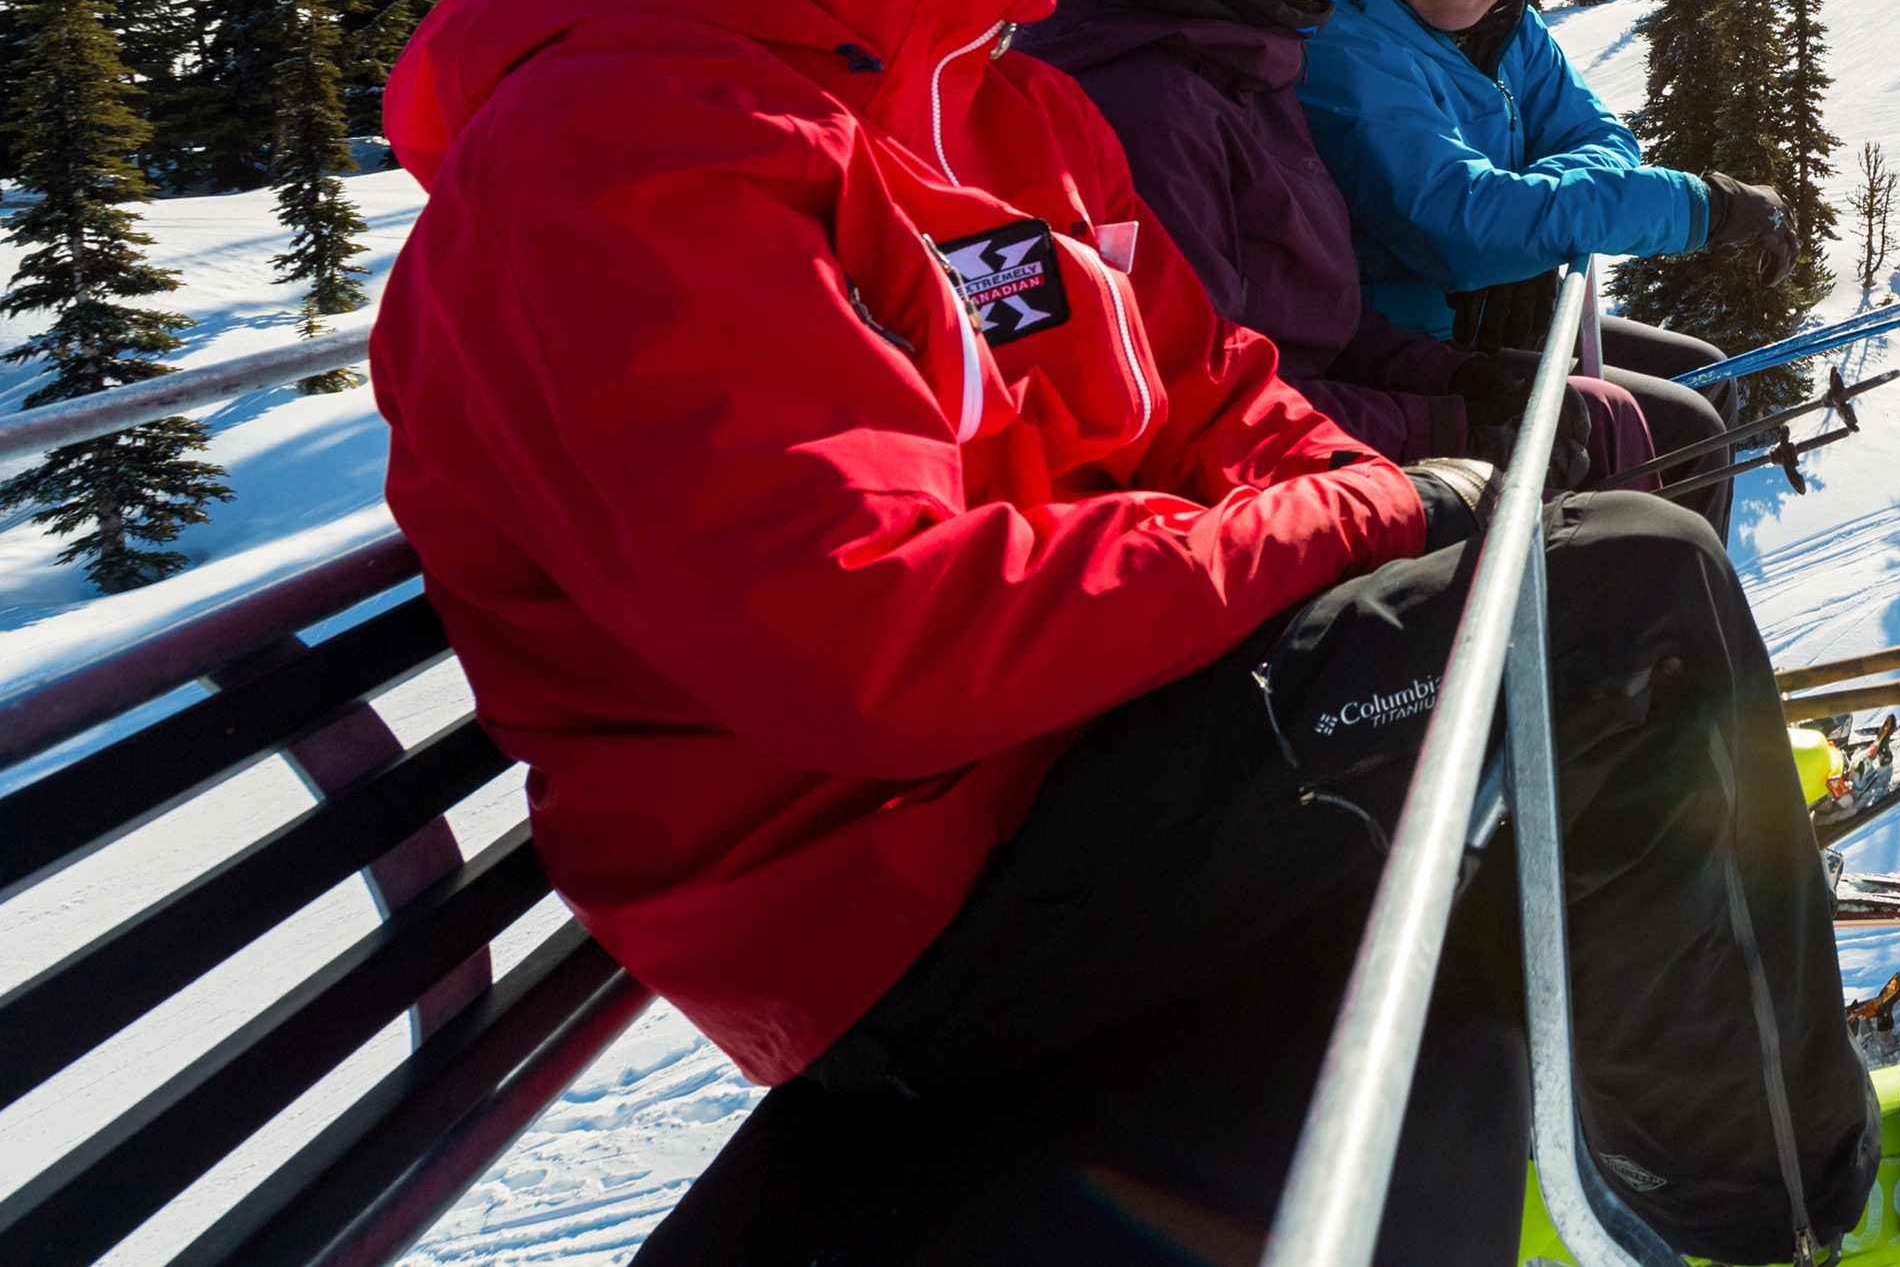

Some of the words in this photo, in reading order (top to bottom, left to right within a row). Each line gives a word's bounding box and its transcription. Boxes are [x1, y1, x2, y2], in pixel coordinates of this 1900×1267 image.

[955, 265, 1038, 298] EXTREMELY
[970, 277, 1041, 306] ANADIAN
[1371, 695, 1437, 728] TITANIU
